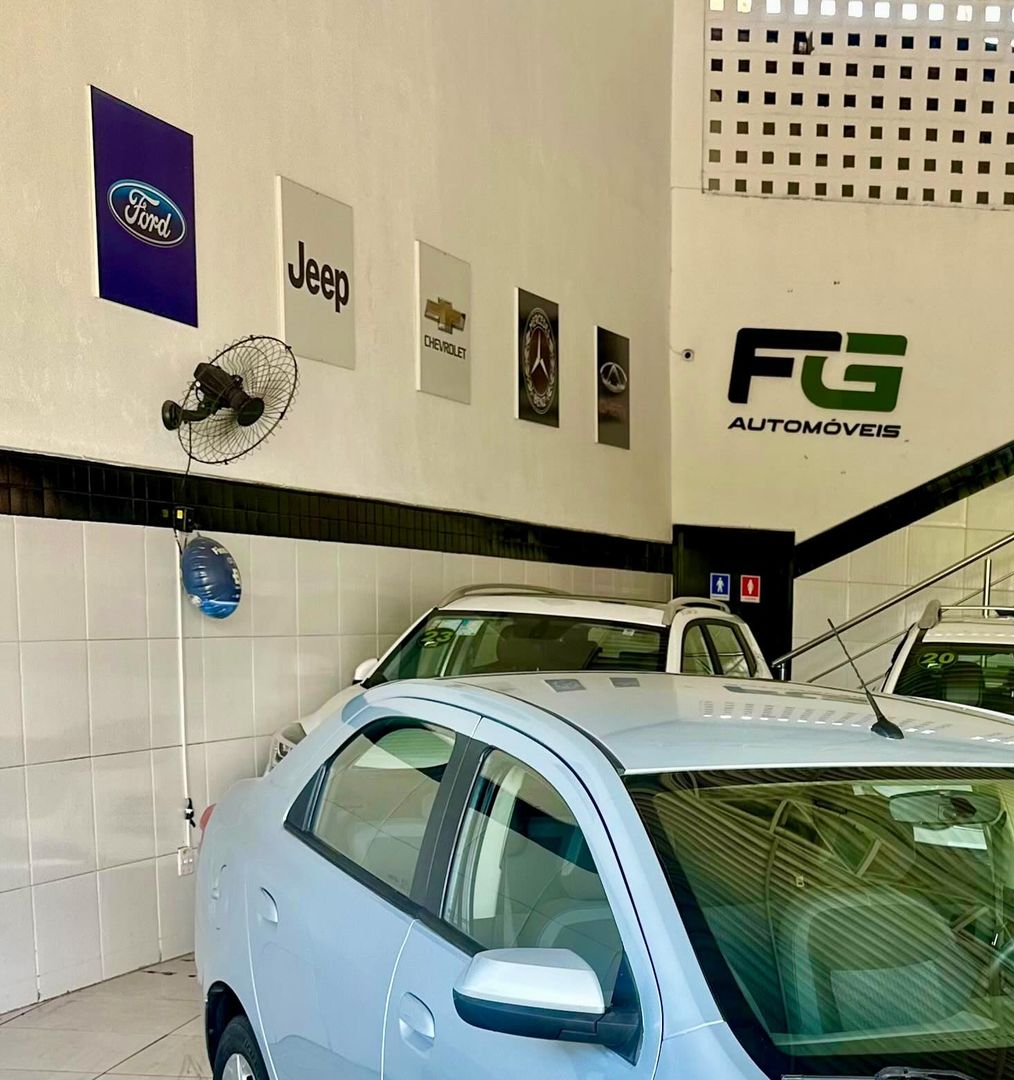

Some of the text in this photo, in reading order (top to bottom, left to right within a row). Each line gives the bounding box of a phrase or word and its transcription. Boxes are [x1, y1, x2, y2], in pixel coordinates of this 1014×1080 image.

[124, 188, 172, 239] Ford
[287, 240, 350, 314] Jeep
[423, 334, 467, 360] CHEVROLET
[727, 327, 908, 413] FG
[727, 416, 902, 439] AUTOMÓVEIS
[421, 631, 454, 642] 23
[920, 652, 955, 664] 20
